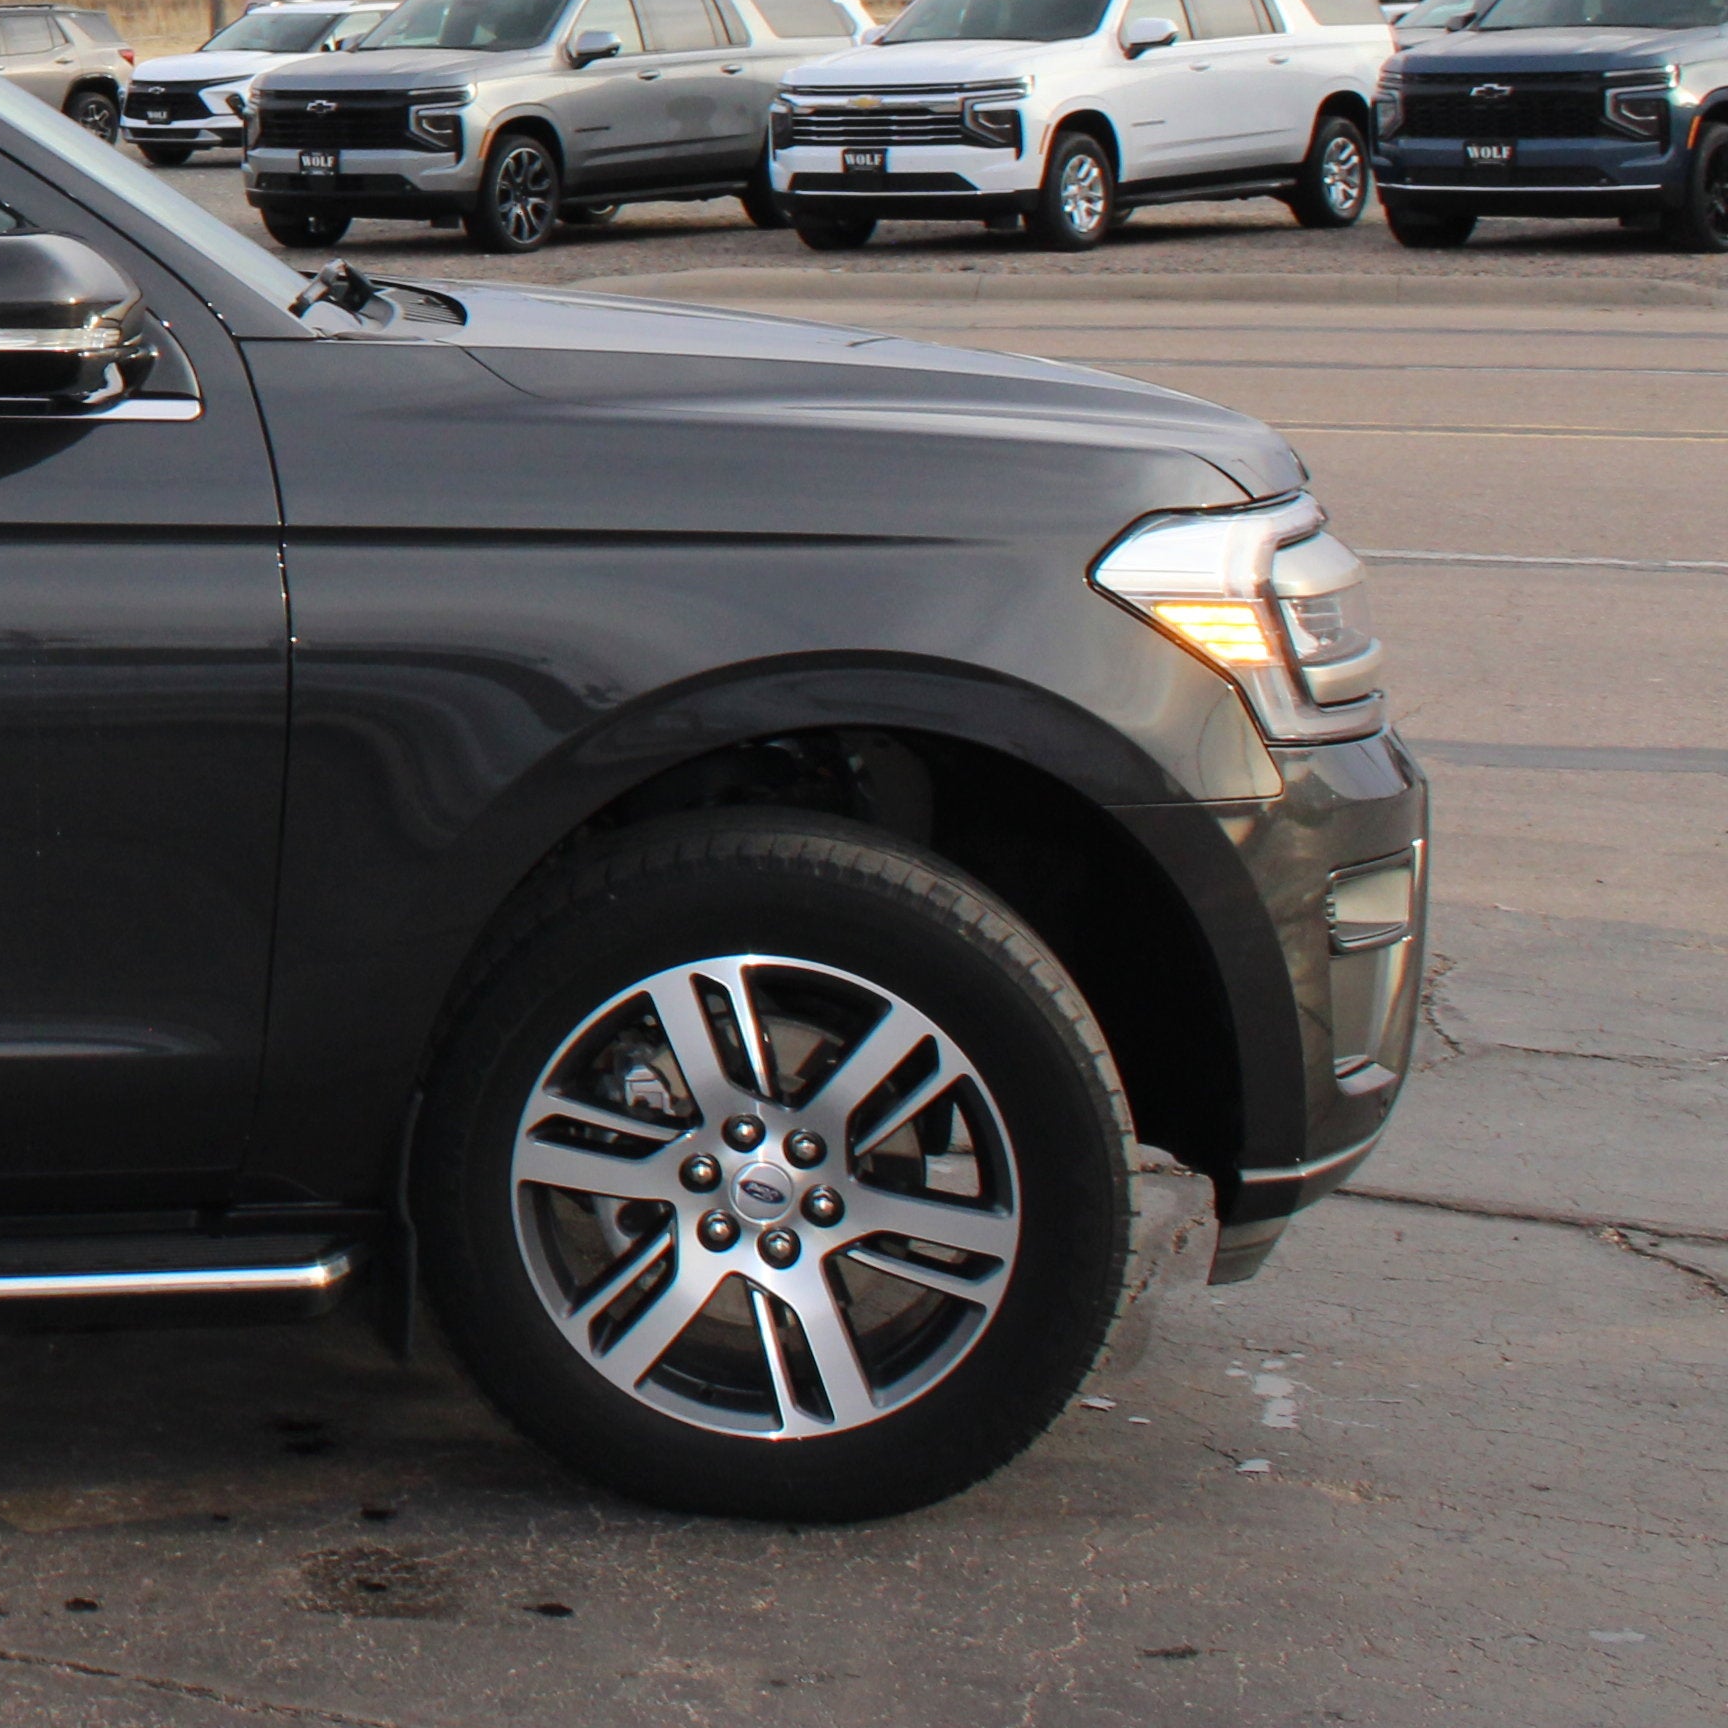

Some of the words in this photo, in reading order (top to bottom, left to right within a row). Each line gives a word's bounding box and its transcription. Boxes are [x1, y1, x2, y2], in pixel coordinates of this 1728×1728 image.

[1466, 146, 1513, 159] WOLF
[301, 155, 336, 168] WOLF
[844, 153, 883, 166] WOLF
